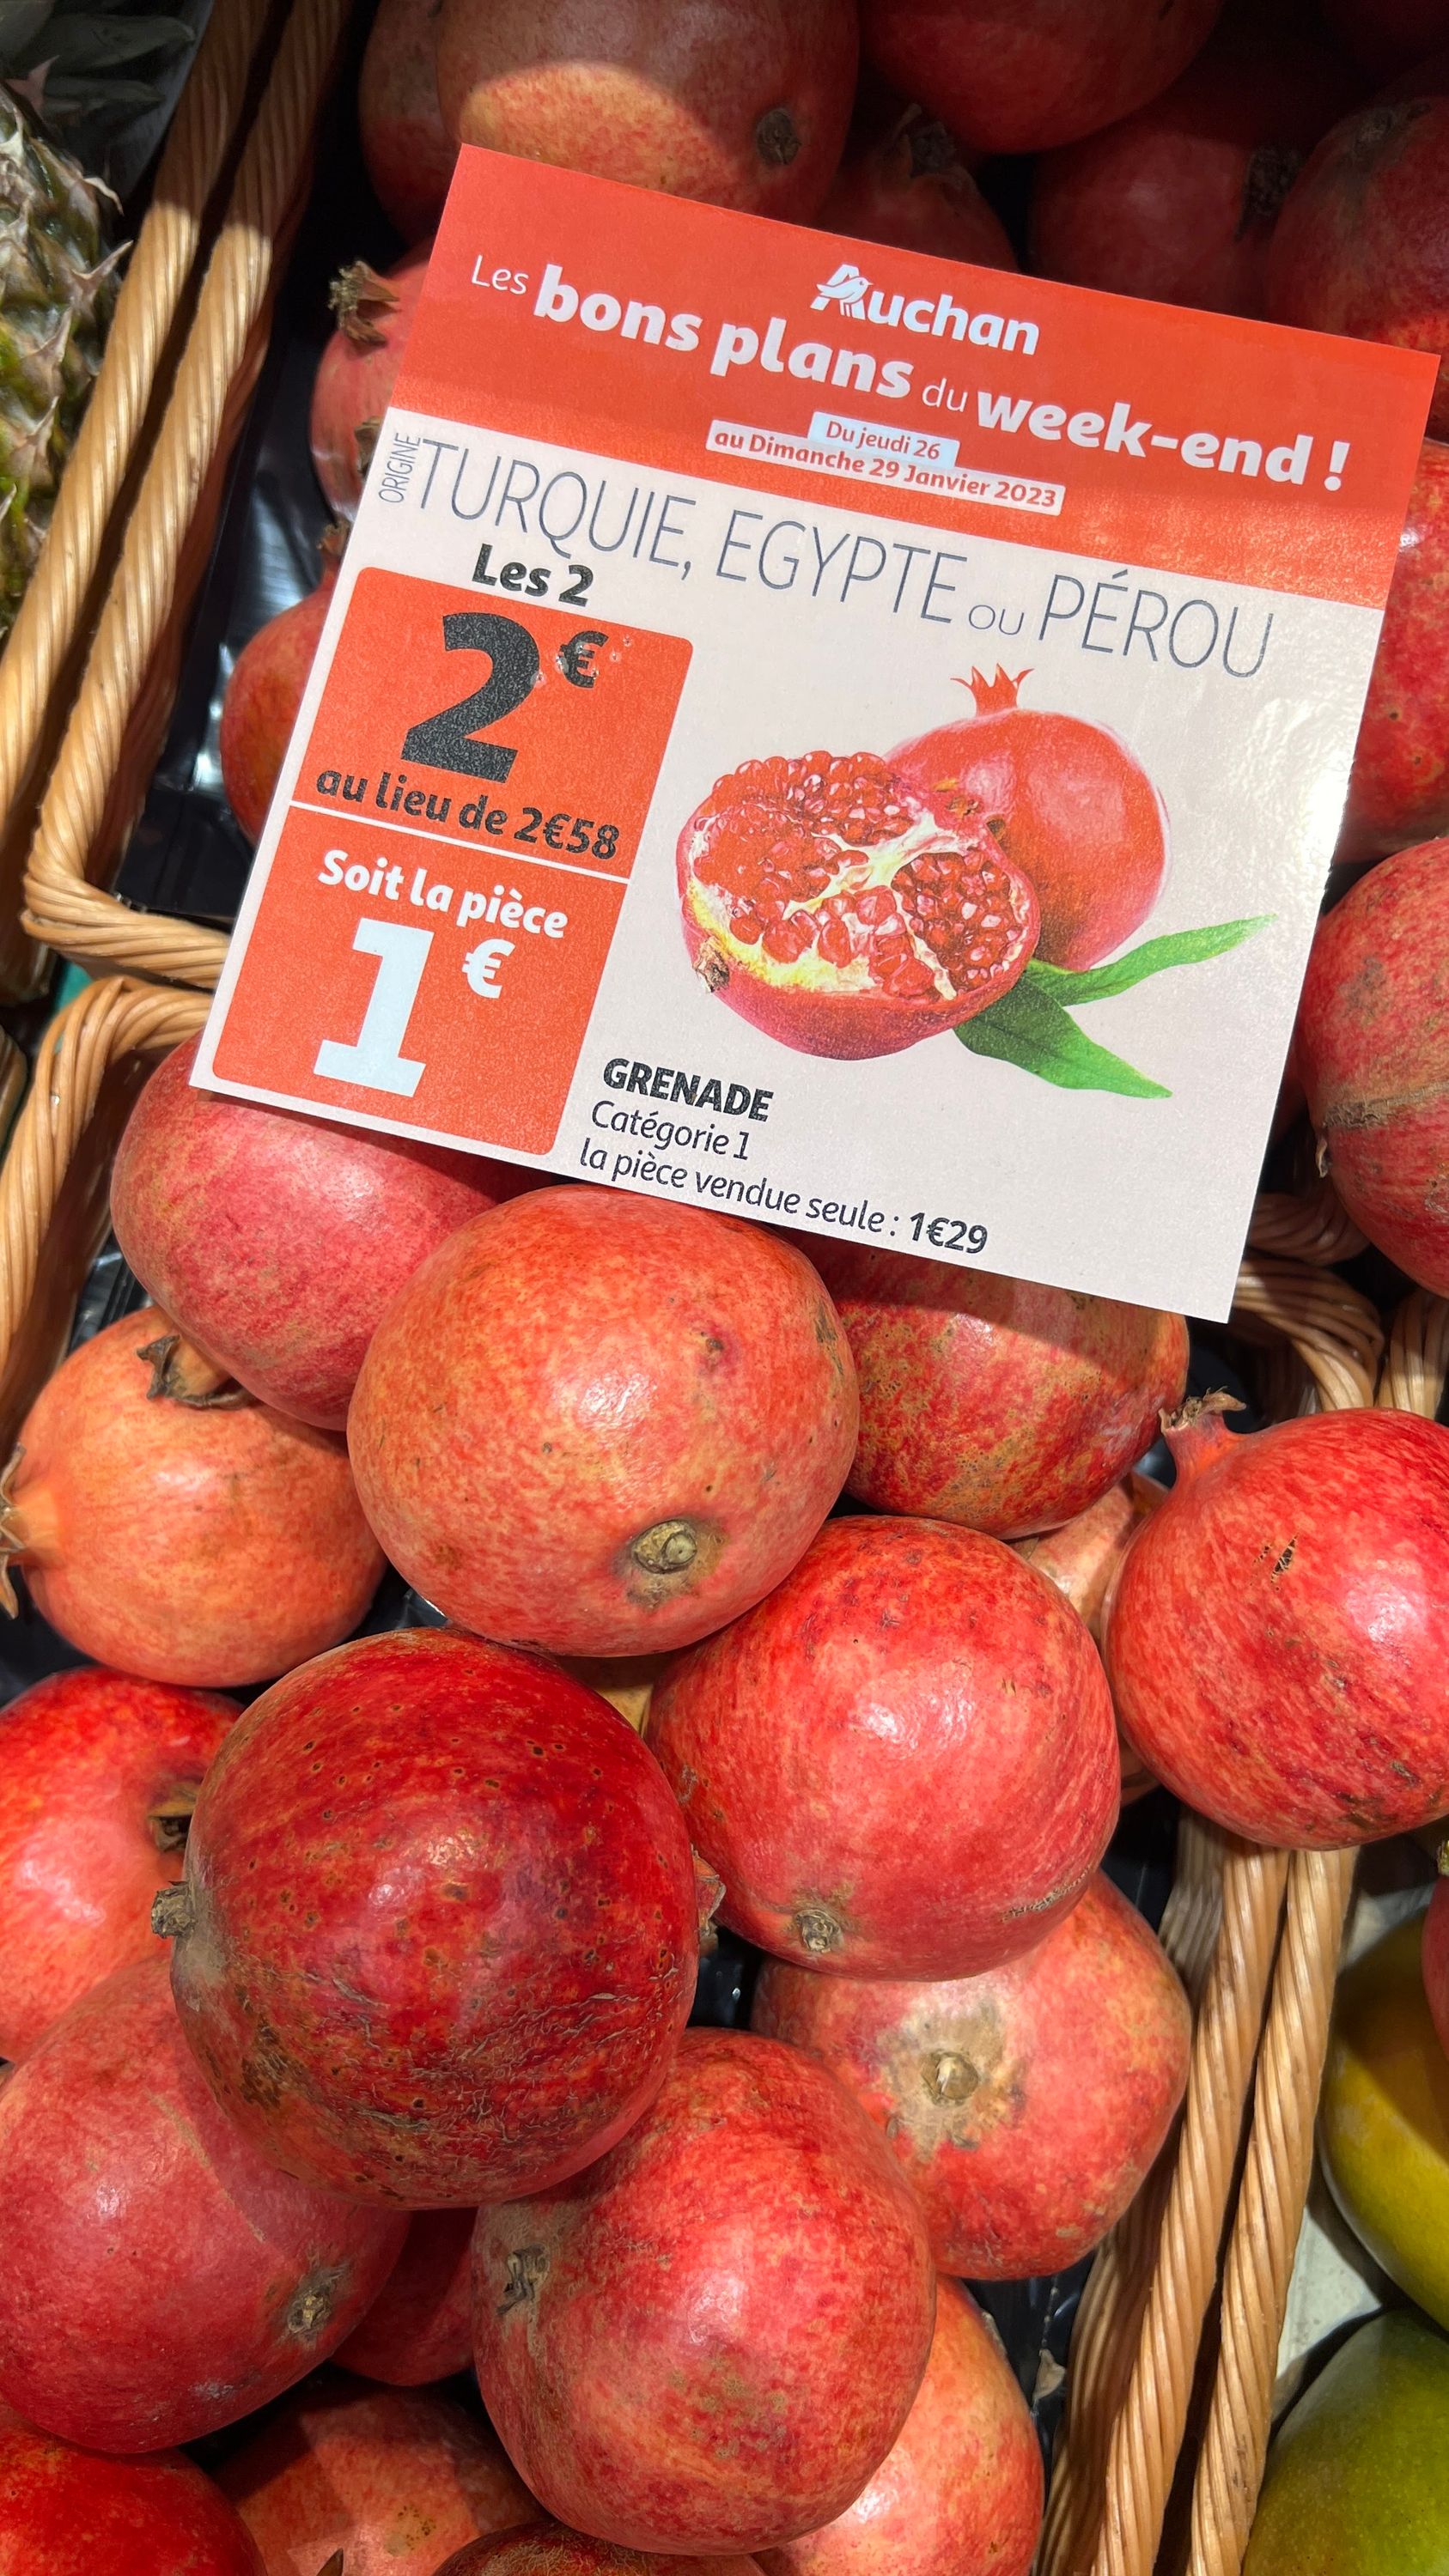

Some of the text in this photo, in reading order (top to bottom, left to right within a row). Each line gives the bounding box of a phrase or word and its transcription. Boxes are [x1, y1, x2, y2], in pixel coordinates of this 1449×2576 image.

[810, 264, 1039, 355] Auchan
[471, 254, 1350, 492] Les bons plans du week-end !
[378, 432, 422, 503] ORIGINE
[714, 429, 1057, 508] au Dimanche 29 Janvier 2023
[826, 420, 941, 461] Du jeudi 26
[420, 438, 1273, 679] TURQUIE, EGYPTE OU PÉROU
[472, 544, 594, 606] Les 2
[400, 612, 539, 783] 2
[316, 770, 621, 860] au lieu de 2€58
[318, 849, 569, 939] Soit la pièce
[313, 917, 435, 1098] 1
[591, 1100, 750, 1160] Catégorie 1
[602, 1057, 774, 1122] GRENADE
[580, 1138, 607, 1170] la
[611, 1150, 688, 1188] pièce
[695, 1170, 801, 1214] vendue
[909, 1212, 988, 1255] 1€29
